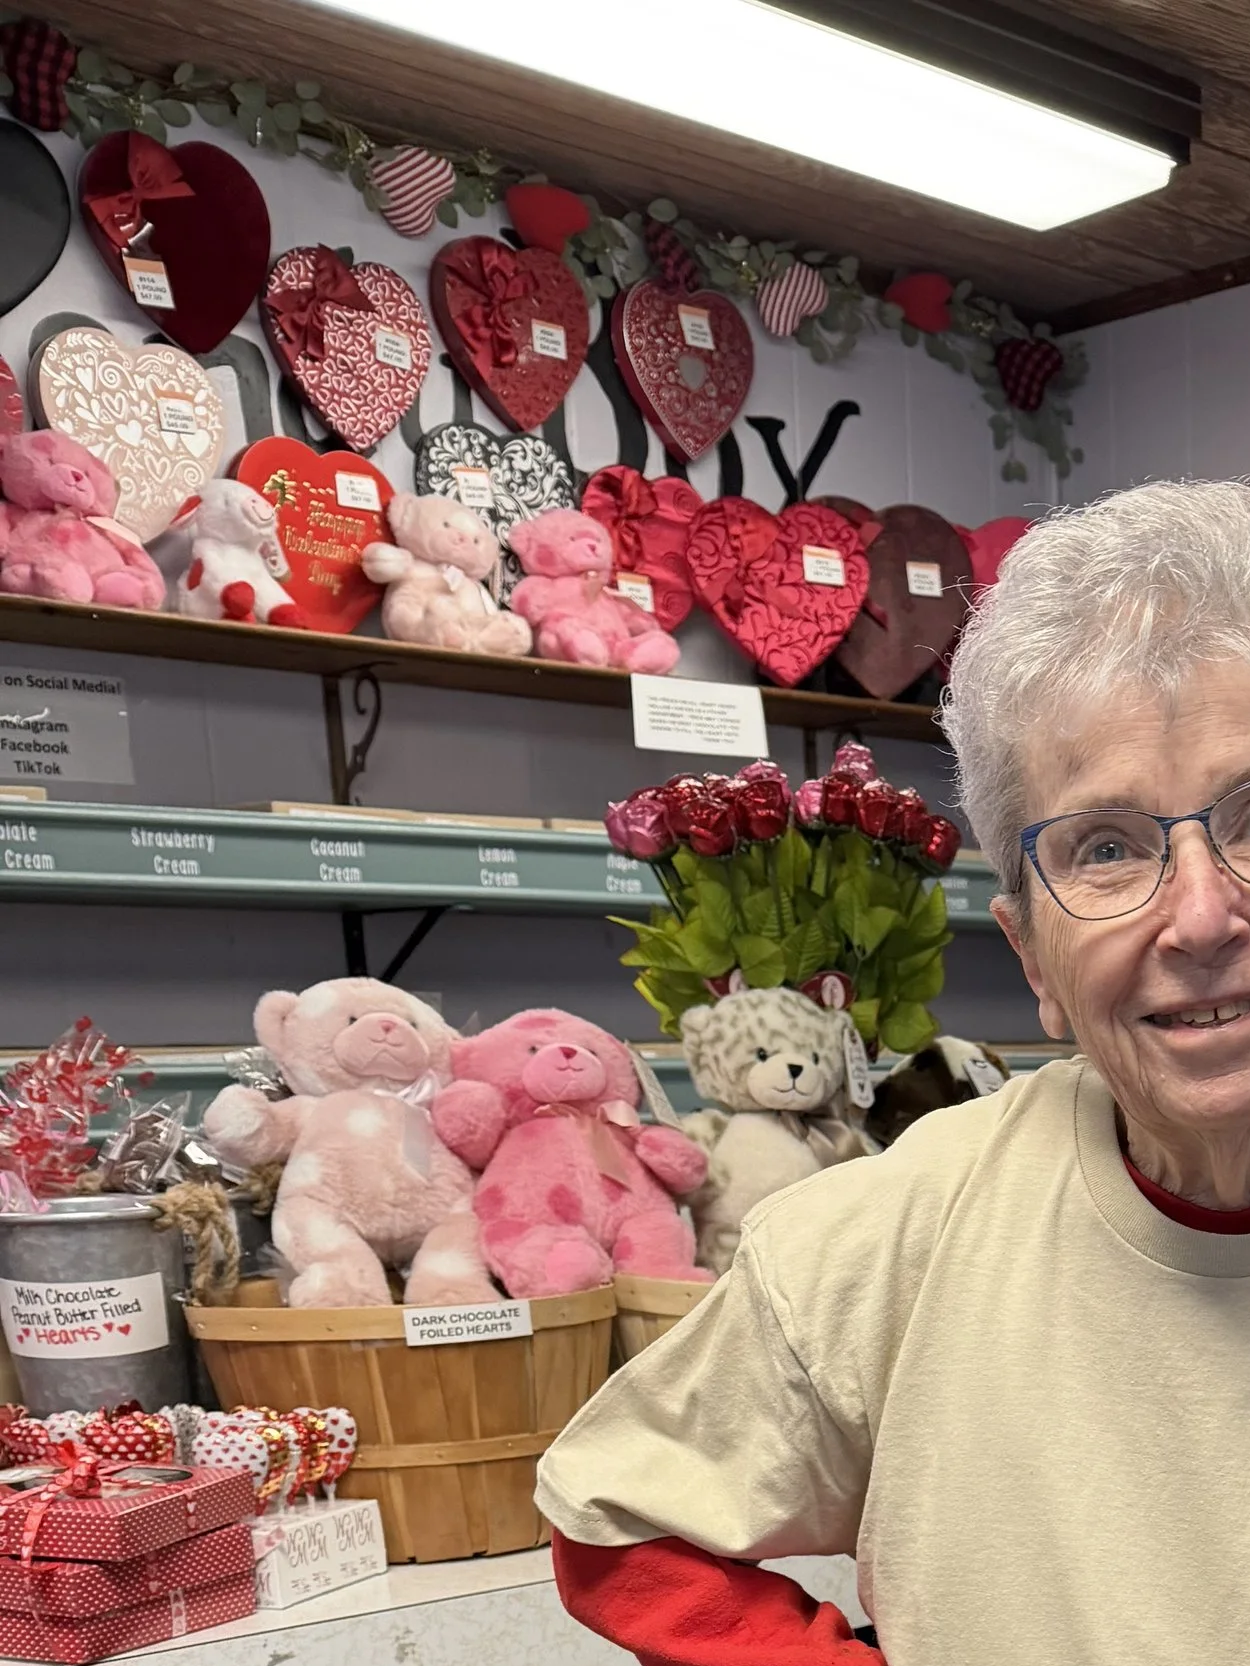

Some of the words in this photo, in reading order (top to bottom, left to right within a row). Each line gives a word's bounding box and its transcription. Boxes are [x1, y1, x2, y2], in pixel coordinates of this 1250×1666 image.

[4, 675, 23, 687] on
[26, 675, 68, 690] Social
[72, 678, 122, 694] Media!
[0, 717, 69, 734] nstagram
[1, 738, 70, 755] Facebook
[14, 760, 61, 775] TikTok
[131, 827, 215, 853] Strawberry
[310, 838, 366, 857] Coconut
[4, 849, 55, 870] Cream
[478, 845, 517, 864] Lemon
[153, 854, 200, 876] Cream
[319, 862, 362, 883] Cream
[480, 868, 519, 887] Cream
[45, 1286, 121, 1305] Chocolate
[11, 1305, 51, 1326] Peanut
[54, 1307, 98, 1326] Butter
[100, 1299, 142, 1319] Filled
[412, 1316, 446, 1326] DARK
[449, 1307, 520, 1323] CHOCOLATE
[35, 1326, 101, 1345] Hearts
[420, 1328, 464, 1339] FOILED
[467, 1322, 512, 1335] HEARTS
